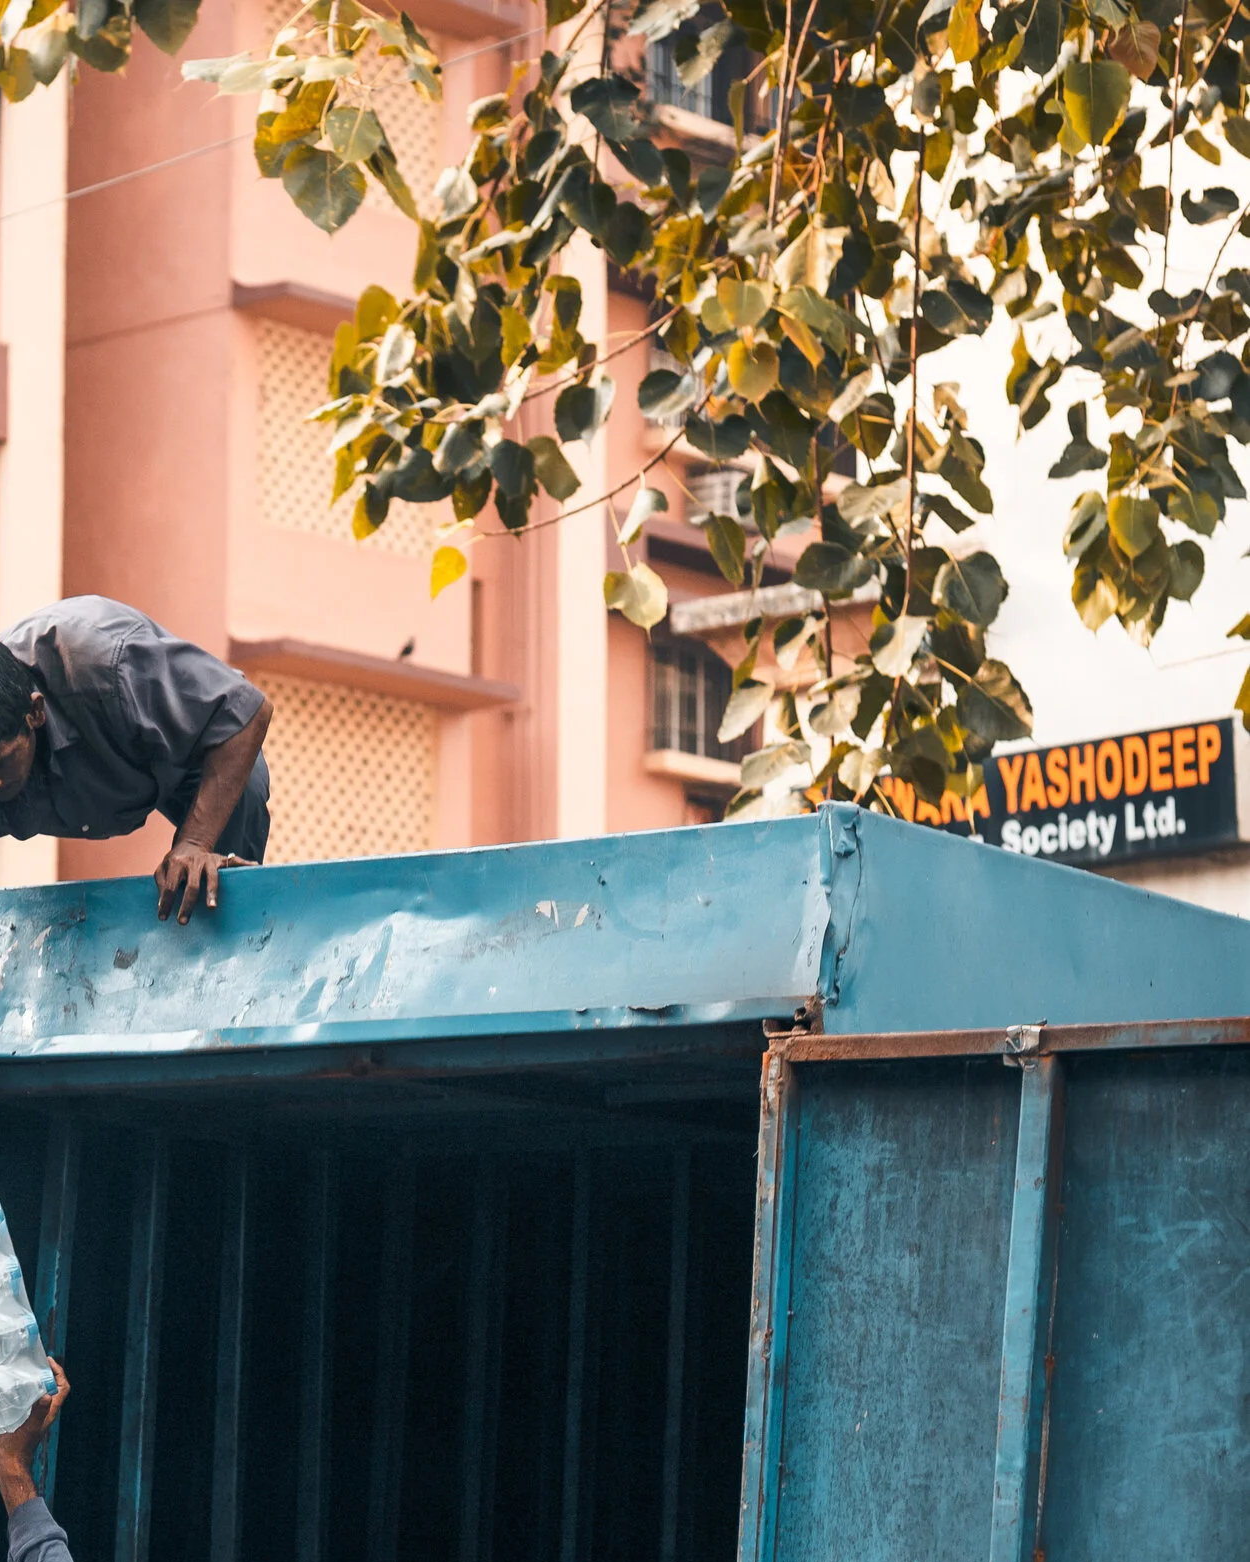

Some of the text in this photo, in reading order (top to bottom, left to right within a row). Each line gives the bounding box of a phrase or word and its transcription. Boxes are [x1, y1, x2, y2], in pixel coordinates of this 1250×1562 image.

[997, 723, 1223, 814] YASHODEEP
[1000, 795, 1187, 857] Society Ltd.
